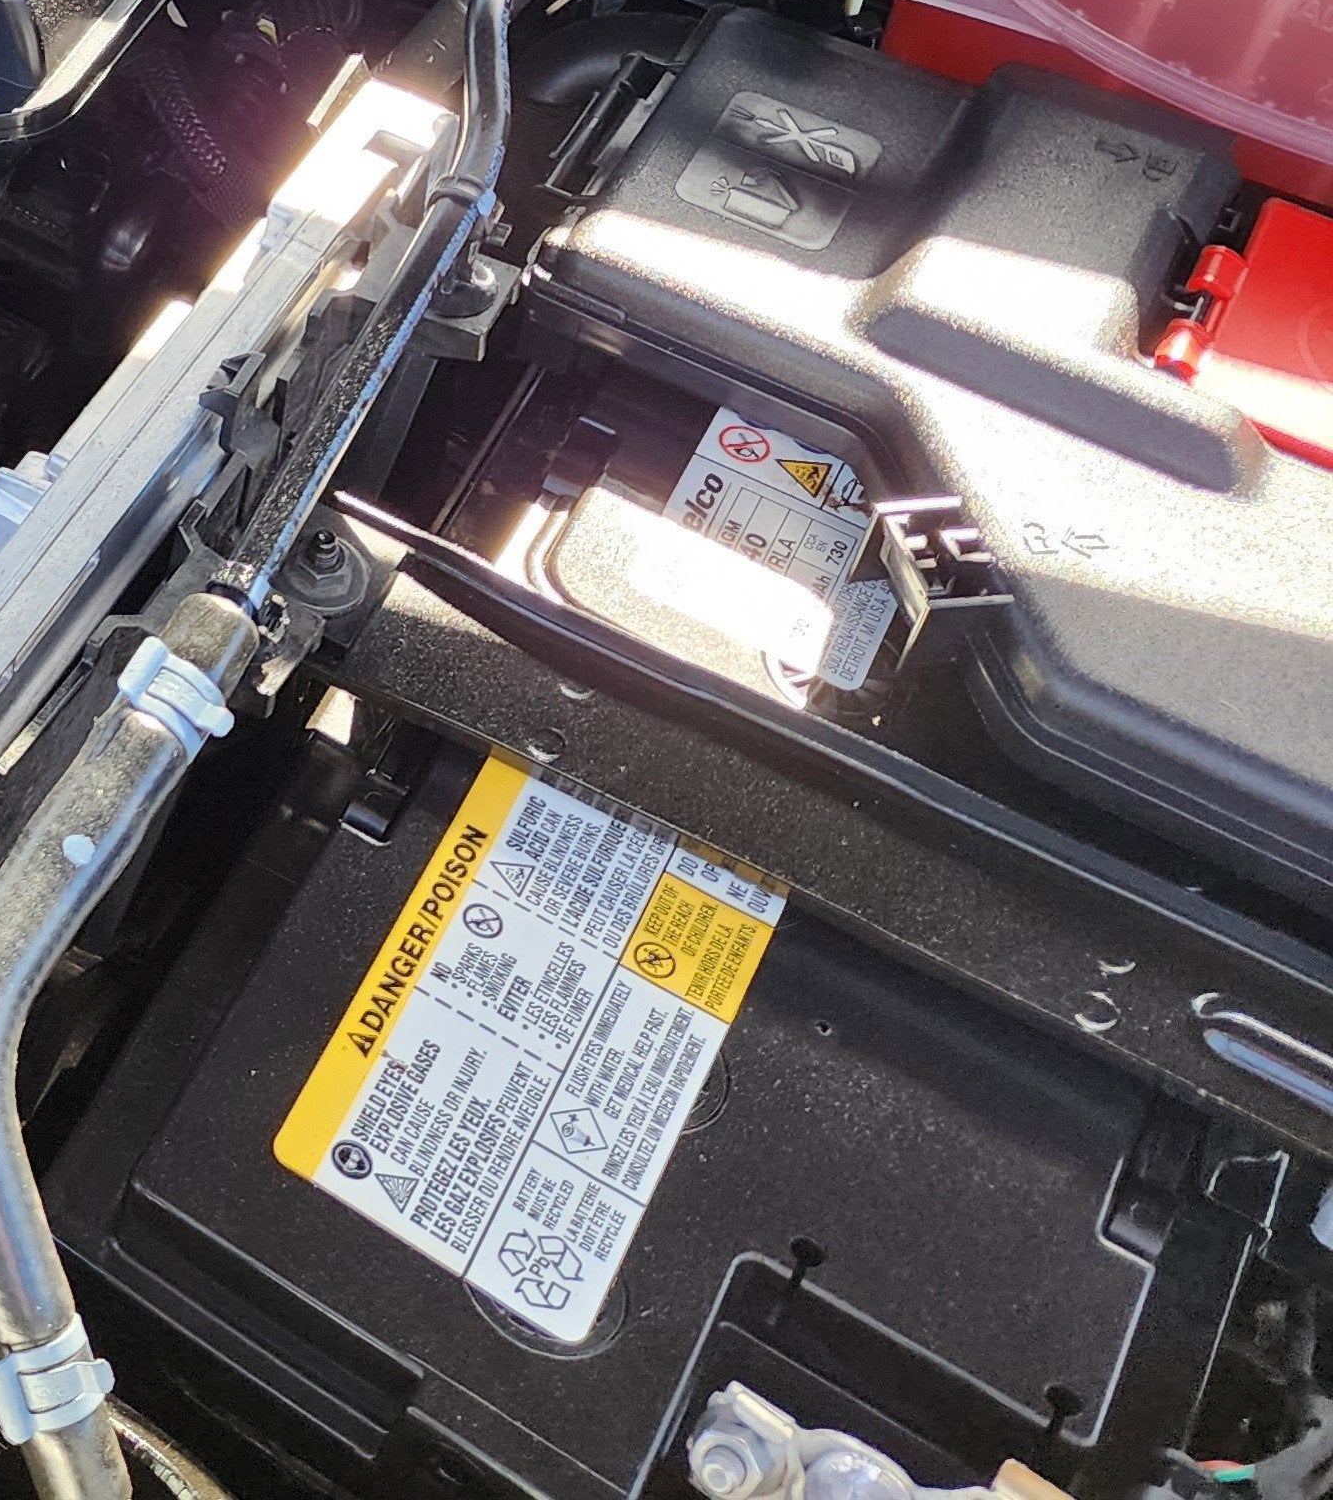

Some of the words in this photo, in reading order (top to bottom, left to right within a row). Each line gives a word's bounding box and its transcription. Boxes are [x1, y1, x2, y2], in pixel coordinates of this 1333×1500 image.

[681, 472, 724, 529] elco
[742, 532, 768, 560] 40
[767, 538, 797, 567] RLA
[825, 540, 848, 566] 730
[866, 597, 891, 623] U.S.A.
[823, 655, 843, 675] 300
[837, 586, 876, 655] RENAISSANCE
[859, 622, 877, 637] MI
[838, 635, 873, 682] DETROIT,
[506, 795, 547, 852] SULFURIC
[524, 830, 550, 863] ACID
[540, 809, 563, 834] CAN
[571, 822, 604, 861] BURNS.
[525, 869, 555, 907] CAUSE
[542, 813, 584, 874] BLINDNESS
[560, 883, 596, 928] L'ACIDE
[581, 819, 628, 888] SULFURIQUE
[676, 856, 699, 878] DO
[551, 857, 585, 901] SEVERE
[583, 907, 610, 939] PEUT
[597, 867, 631, 911] CAUSER
[617, 852, 639, 870] LA
[620, 853, 660, 912] BRÛLURES
[662, 883, 677, 899] OF
[726, 881, 749, 902] NE
[543, 897, 564, 917] OR
[653, 894, 674, 916] OUT
[670, 899, 692, 931] REACH
[747, 885, 774, 914] OUV
[358, 824, 489, 1034] DANGER/POISON
[602, 928, 622, 949] OU
[609, 908, 633, 933] DES
[643, 912, 664, 937] KEEP
[661, 926, 683, 947] THE
[714, 923, 734, 939] LA
[680, 941, 696, 957] OF
[698, 948, 721, 976] HORS
[708, 935, 728, 952] DE
[430, 961, 452, 983] NO
[451, 942, 483, 984] SPARKS
[466, 950, 498, 994] FLAMES
[481, 952, 518, 1002] SMOKING
[529, 941, 575, 1005] ÉTINCELLES
[720, 961, 739, 979] DE
[493, 972, 533, 1022] ÉVITER
[548, 959, 587, 1014] FLAMMES
[684, 972, 710, 1001] TENIR
[521, 1001, 545, 1026] LES
[538, 1010, 561, 1036] LES
[562, 987, 594, 1029] FUMER
[591, 979, 633, 1044] IMMEDIATELY
[554, 1024, 575, 1045] DE
[631, 1031, 655, 1060] HELP
[649, 1006, 695, 1078] IMMÉDIATEMENT.
[451, 1046, 488, 1094] INJURY.
[580, 1039, 604, 1068] EYES
[667, 1033, 707, 1091] RAPIDEMENT.
[494, 1060, 533, 1119] PEUVENT
[564, 1062, 592, 1099] FLUSH
[583, 1079, 609, 1109] WITH
[596, 1047, 626, 1083] WATER.
[612, 1057, 645, 1101] MEDICAL
[638, 1073, 663, 1102] L'EAU
[368, 1080, 420, 1155] EXPLOSIVE
[406, 1039, 441, 1085] GASES
[442, 1090, 464, 1112] OR
[456, 1095, 492, 1135] YEUX.
[511, 1074, 552, 1133] AVEUGLE.
[602, 1095, 624, 1120] GET
[631, 1096, 652, 1110] À
[650, 1086, 681, 1129] MÉDECIN
[350, 1094, 387, 1142] SHIELD
[390, 1136, 415, 1166] CAN
[403, 1097, 435, 1140] CAUSE
[624, 1103, 649, 1130] YEUX
[643, 1123, 664, 1142] UN
[408, 1109, 454, 1178] BLINDNESS
[444, 1131, 471, 1162] LES
[457, 1113, 507, 1188] EXPLOSIFS
[487, 1127, 524, 1180] RENDRE
[616, 1127, 638, 1149] LES
[601, 1143, 630, 1180] RINCEZ
[621, 1137, 658, 1191] CONSULTEZ
[409, 1156, 459, 1230] PROTÉGEZ
[443, 1182, 472, 1216] GAZ
[477, 1176, 499, 1199] OU
[512, 1166, 542, 1213] BATTERY
[527, 1189, 550, 1222] MUST
[540, 1177, 557, 1194] BE
[542, 1179, 575, 1231] RECYCLED
[569, 1181, 602, 1230] BATTERIE
[429, 1212, 457, 1243] LES
[450, 1195, 490, 1255] BLESSER
[587, 1200, 612, 1228] ÊTRE
[563, 1227, 580, 1244] LA
[578, 1224, 599, 1253] DOIT
[593, 1209, 627, 1262] RECYCLÉE
[528, 1256, 551, 1279] Pb
